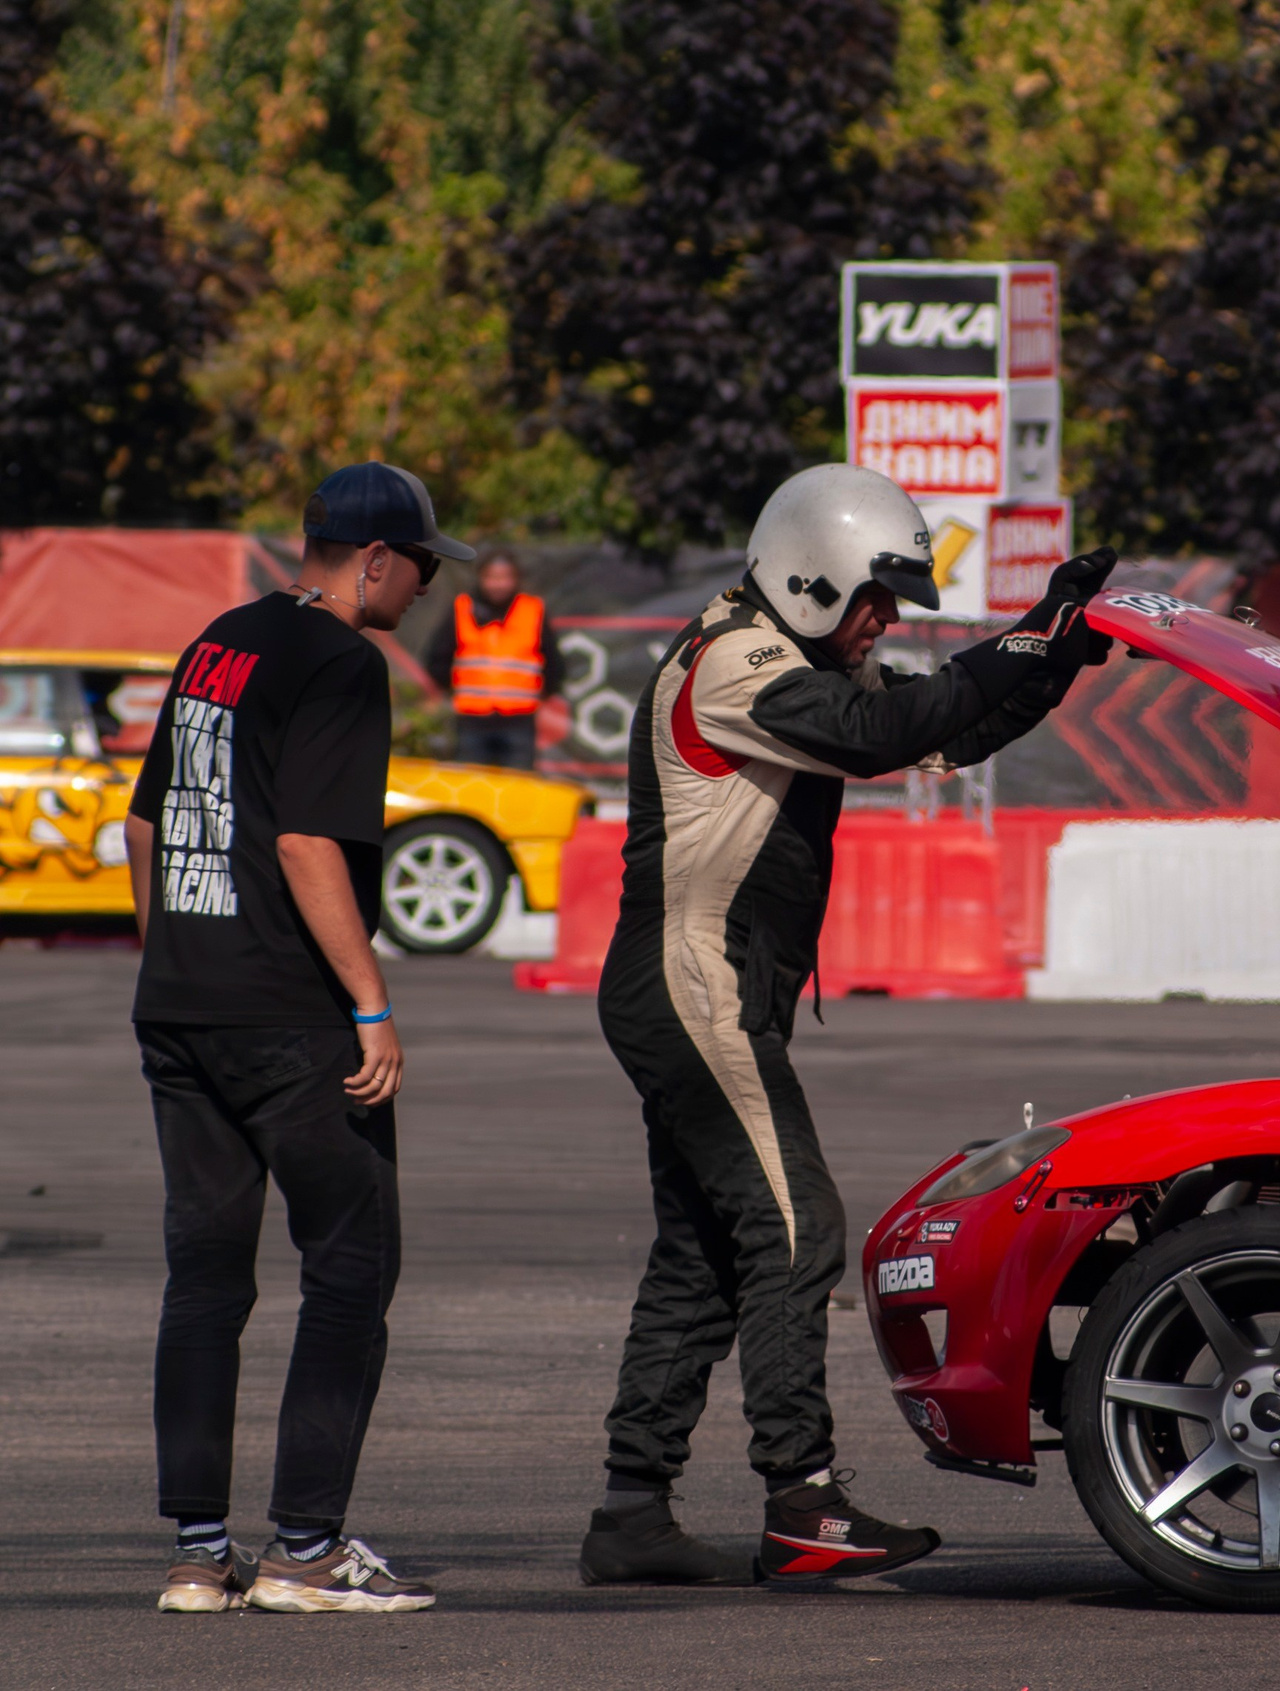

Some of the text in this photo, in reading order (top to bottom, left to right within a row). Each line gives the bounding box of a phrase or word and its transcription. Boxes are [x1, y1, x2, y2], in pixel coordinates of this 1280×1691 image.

[857, 302, 998, 346] YUKA
[863, 401, 996, 442] ДЖИМ
[1005, 638, 1048, 655] sparco
[178, 642, 260, 707] TEAM
[878, 1256, 935, 1295] mazda
[820, 1522, 851, 1536] OMP
